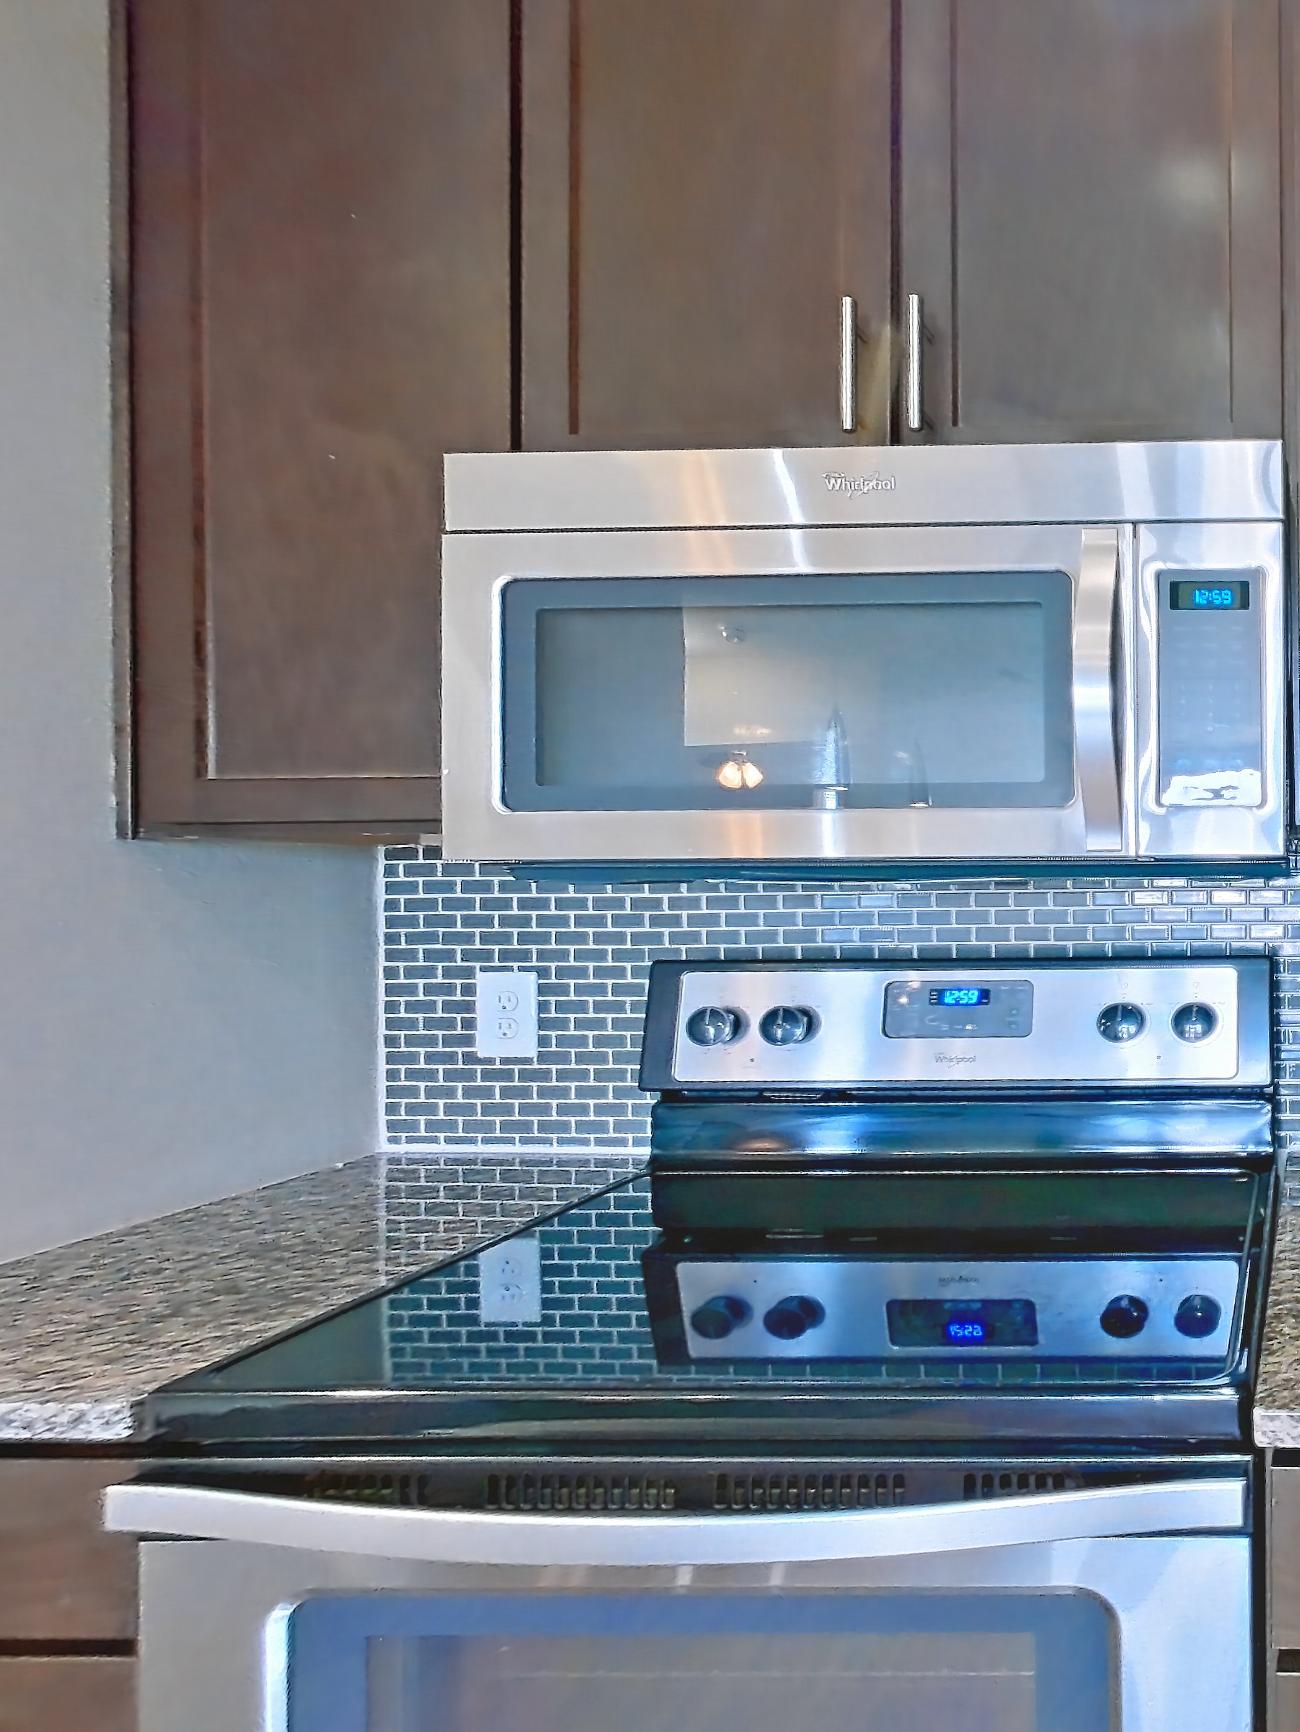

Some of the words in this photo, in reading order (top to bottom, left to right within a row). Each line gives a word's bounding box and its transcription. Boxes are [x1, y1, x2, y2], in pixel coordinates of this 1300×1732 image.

[823, 474, 896, 495] Whirlpool
[1194, 589, 1233, 605] 12:59
[944, 990, 979, 1004] 12:59
